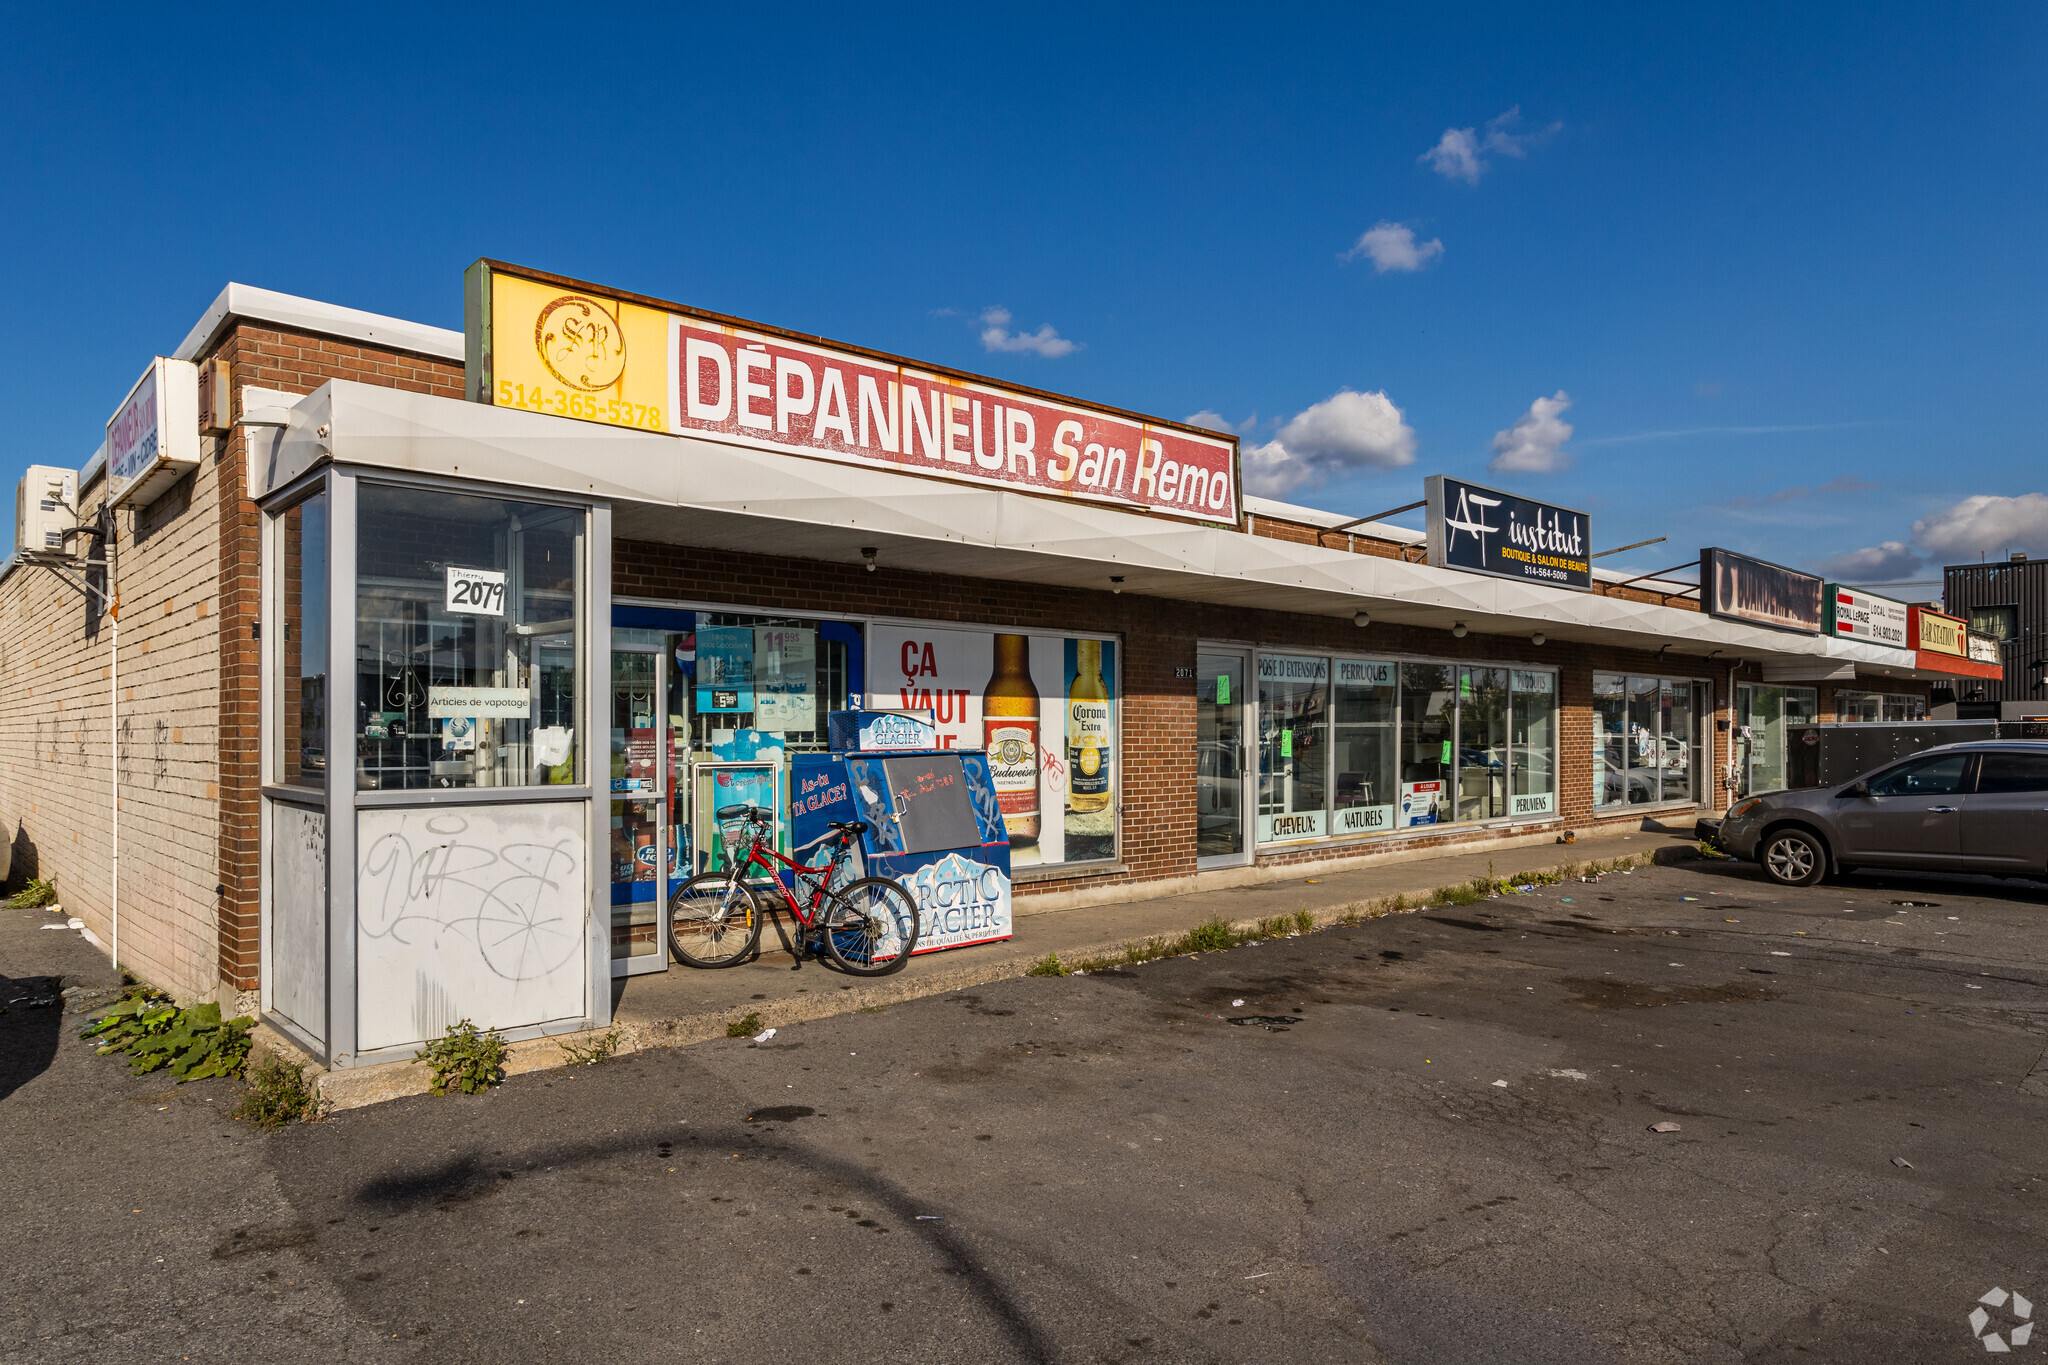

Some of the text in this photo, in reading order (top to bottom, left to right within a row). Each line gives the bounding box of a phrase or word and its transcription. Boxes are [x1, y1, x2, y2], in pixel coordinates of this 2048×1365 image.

[499, 380, 661, 430] 514-365-5378
[686, 337, 1228, 511] DÉPANNEUR San Remo
[1509, 507, 1583, 556] institut
[1502, 547, 1588, 573] BOUTIQUE & SALON DE BEAUTÉ
[452, 570, 483, 583] Thierry
[1525, 566, 1568, 581] 514-564-5006
[452, 580, 504, 611] 2079
[1837, 606, 1852, 620] ROYAL
[1871, 604, 1886, 617] LOCAL
[785, 633, 800, 642] 99$
[1933, 623, 1955, 646] STATION
[901, 640, 938, 687] ÇA
[1259, 659, 1277, 676] POSE
[1176, 668, 1192, 678] 2071
[1341, 663, 1387, 683] PERRUQUES
[469, 698, 482, 706] de
[485, 699, 528, 709] vapotage
[900, 688, 970, 723] VAUT
[1073, 705, 1107, 721] Corona
[875, 718, 922, 734] ARCTIC
[1080, 721, 1101, 731] Extra
[875, 734, 922, 745] GLACIER
[988, 764, 1038, 779] Budweiser
[801, 774, 829, 794] As-tu
[793, 783, 847, 816] TA GLACE?
[1273, 797, 1547, 836] CHEVEUX: NATURELS PERUVIENS
[926, 939, 936, 947] DE
[936, 934, 963, 945] QUALITÉ
